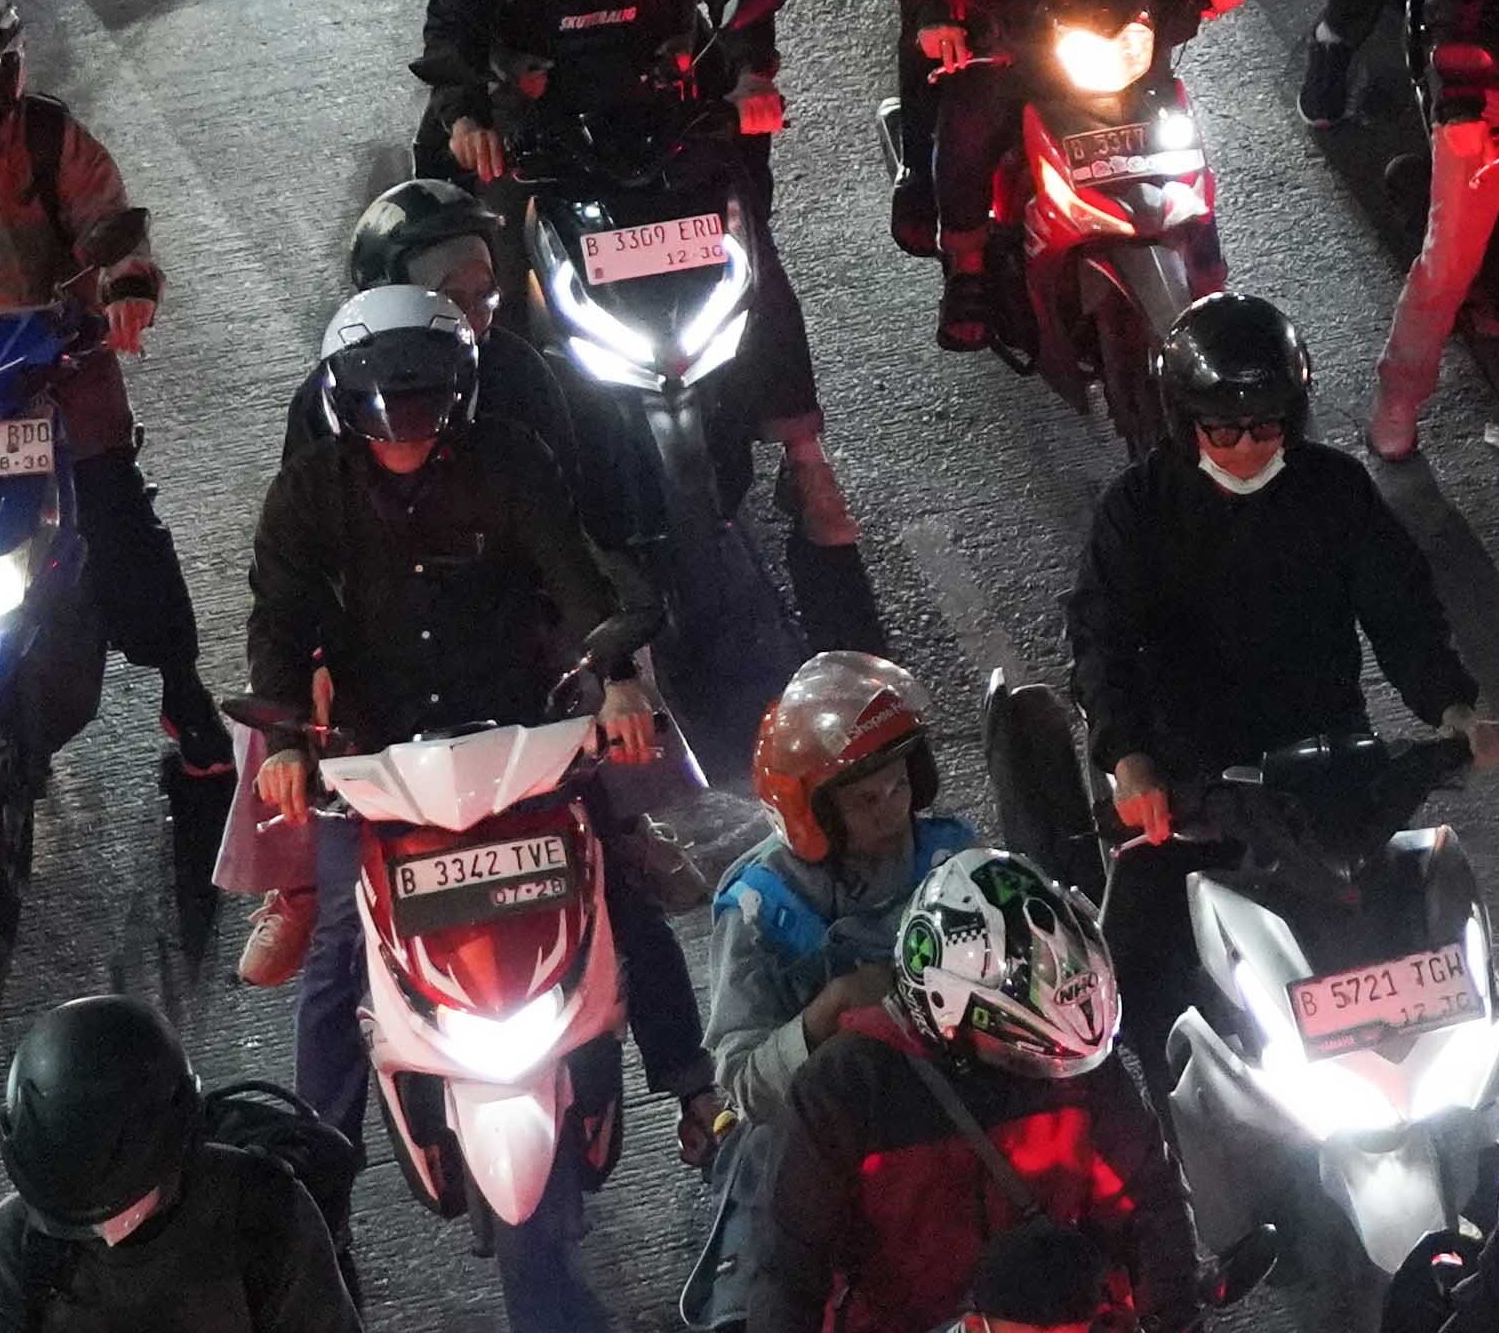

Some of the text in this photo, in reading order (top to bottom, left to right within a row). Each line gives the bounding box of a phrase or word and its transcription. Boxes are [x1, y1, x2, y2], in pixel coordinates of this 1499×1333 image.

[586, 215, 721, 257] B 3309 ERU
[401, 839, 565, 895] B 3342 TVE
[1301, 989, 1317, 1018] B
[1332, 969, 1398, 1009] 5721
